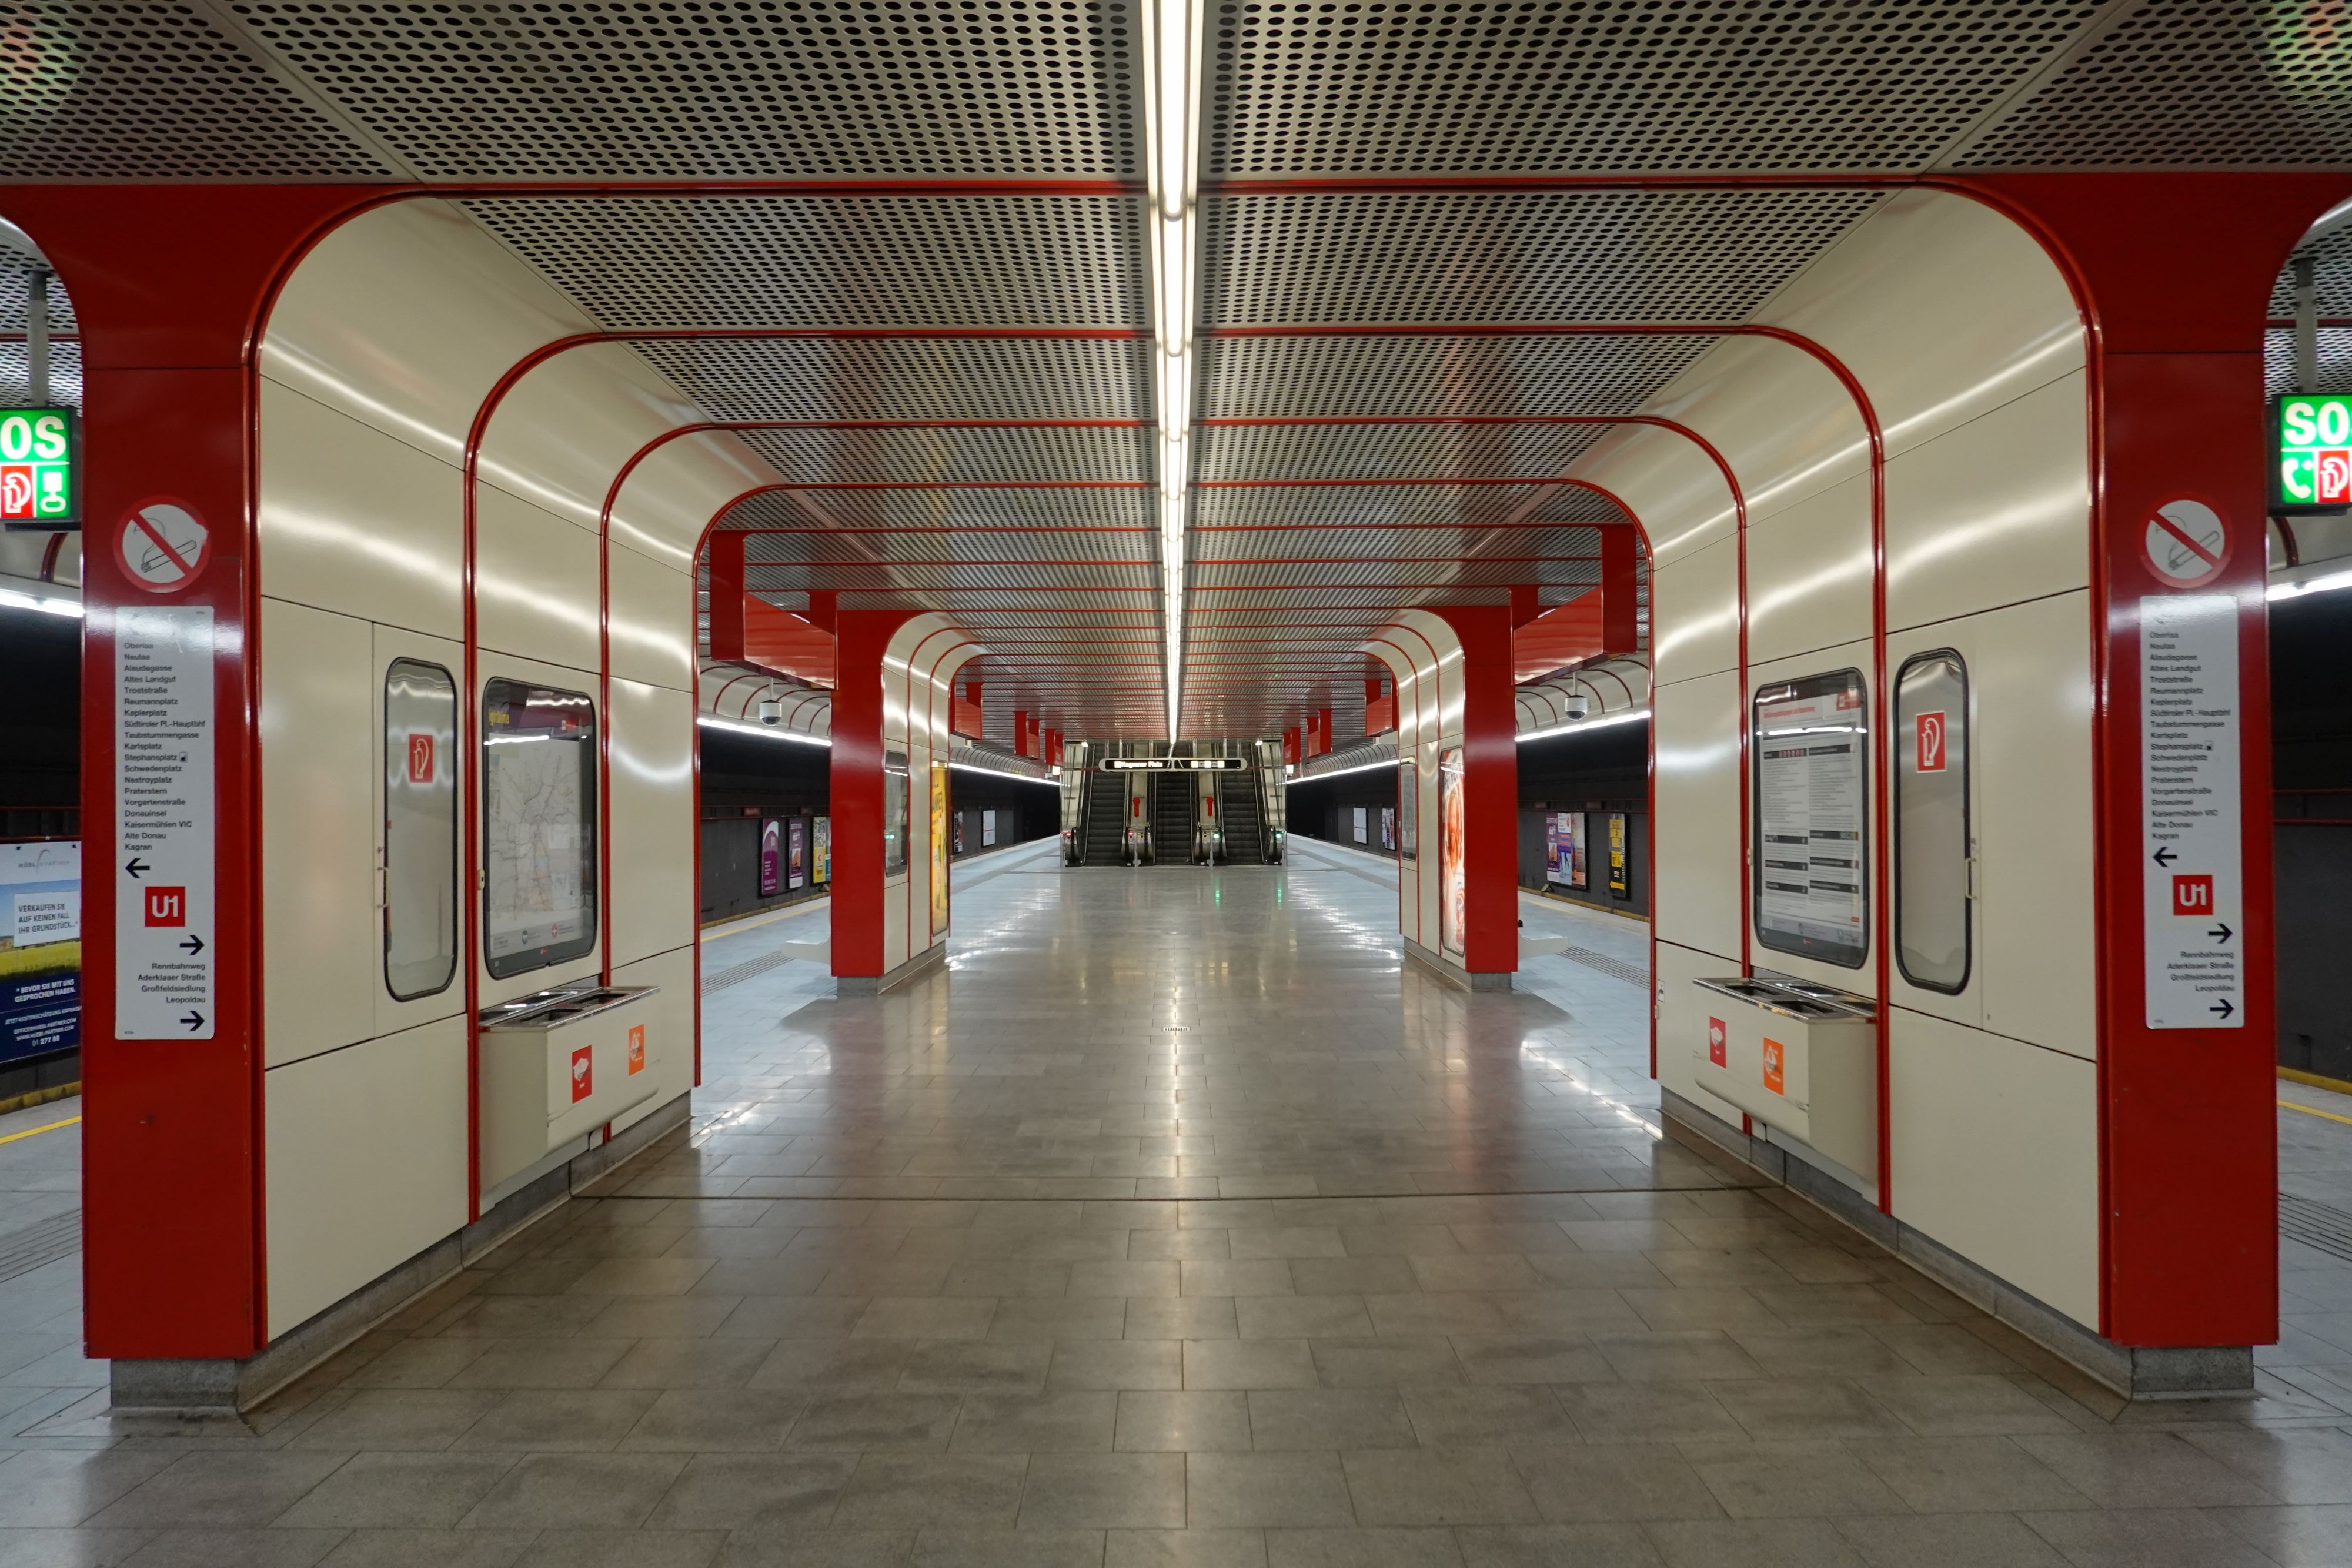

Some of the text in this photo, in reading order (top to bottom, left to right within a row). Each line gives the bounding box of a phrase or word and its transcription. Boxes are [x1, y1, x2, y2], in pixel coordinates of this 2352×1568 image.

[2284, 402, 2352, 446] SO
[124, 665, 172, 673] Alaudagasse
[145, 676, 176, 684] Landgut
[124, 754, 178, 762] Stephansplatz
[124, 776, 172, 784] Nestroyplatz
[124, 798, 186, 807] Vorgartenstraße
[125, 843, 152, 852] Kagran
[2179, 884, 2207, 907] U1
[152, 895, 179, 918] U1
[34, 914, 56, 922] KEINEN
[152, 962, 206, 971] Rennbahnweg
[21, 984, 41, 994] BEVOR
[141, 985, 206, 993] Großfeldsiedlung
[15, 990, 54, 1002] GESPROCHEN
[166, 996, 206, 1004] Leopoldau
